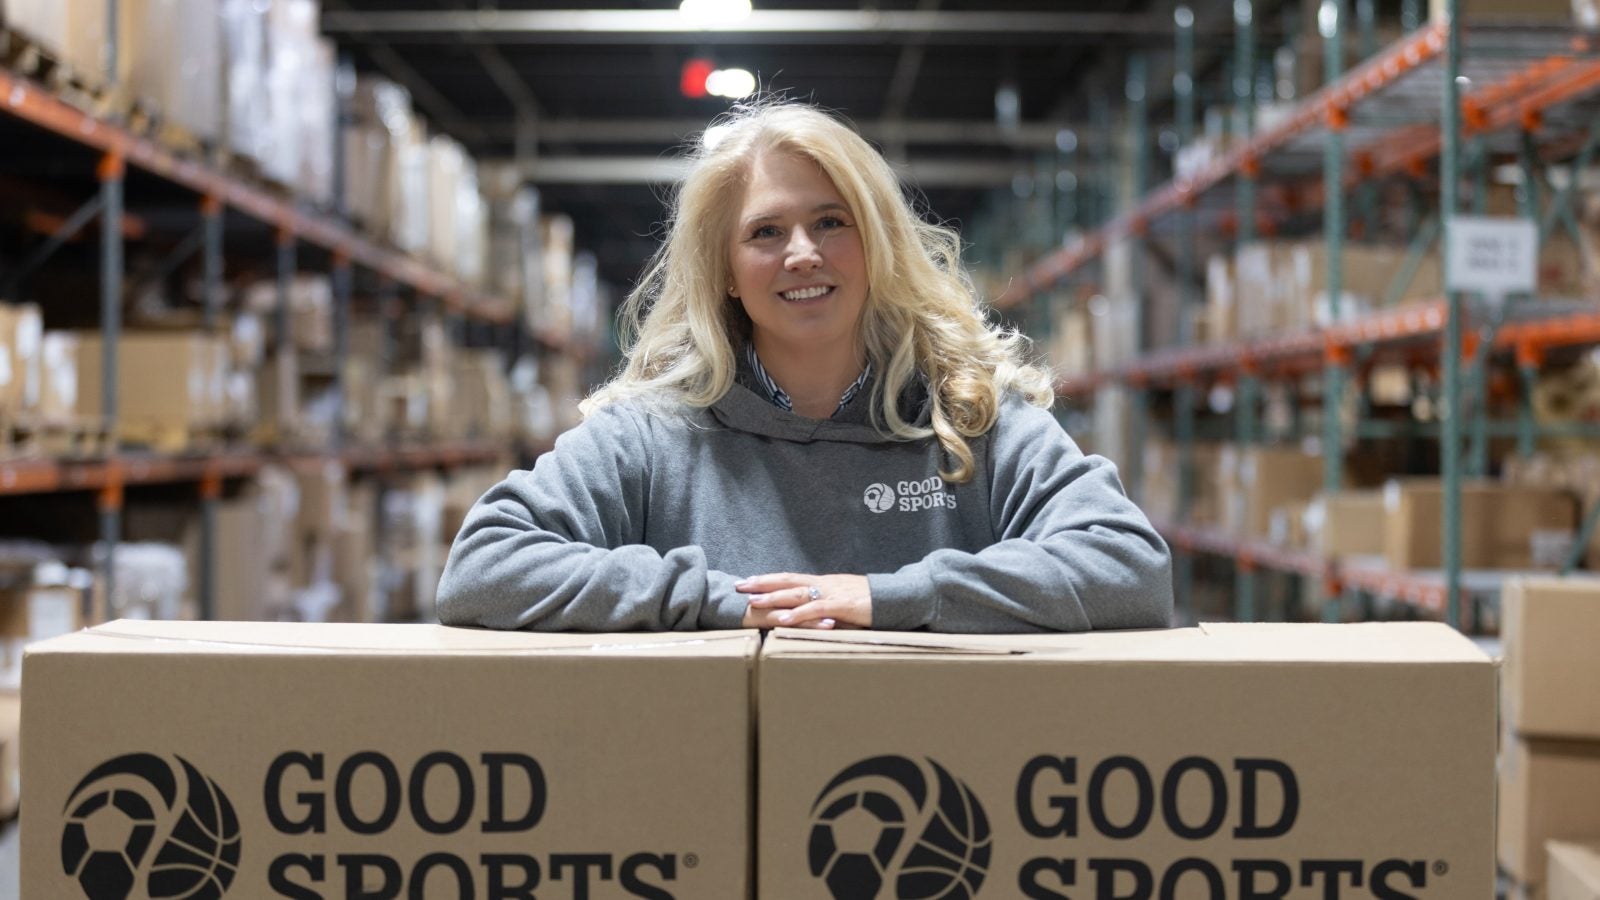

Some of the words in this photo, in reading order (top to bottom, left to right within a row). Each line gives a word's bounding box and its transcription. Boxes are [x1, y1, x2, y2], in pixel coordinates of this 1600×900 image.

[897, 476, 943, 496] GOOD
[263, 750, 549, 836] GOOD
[1015, 754, 1302, 841] GOOD
